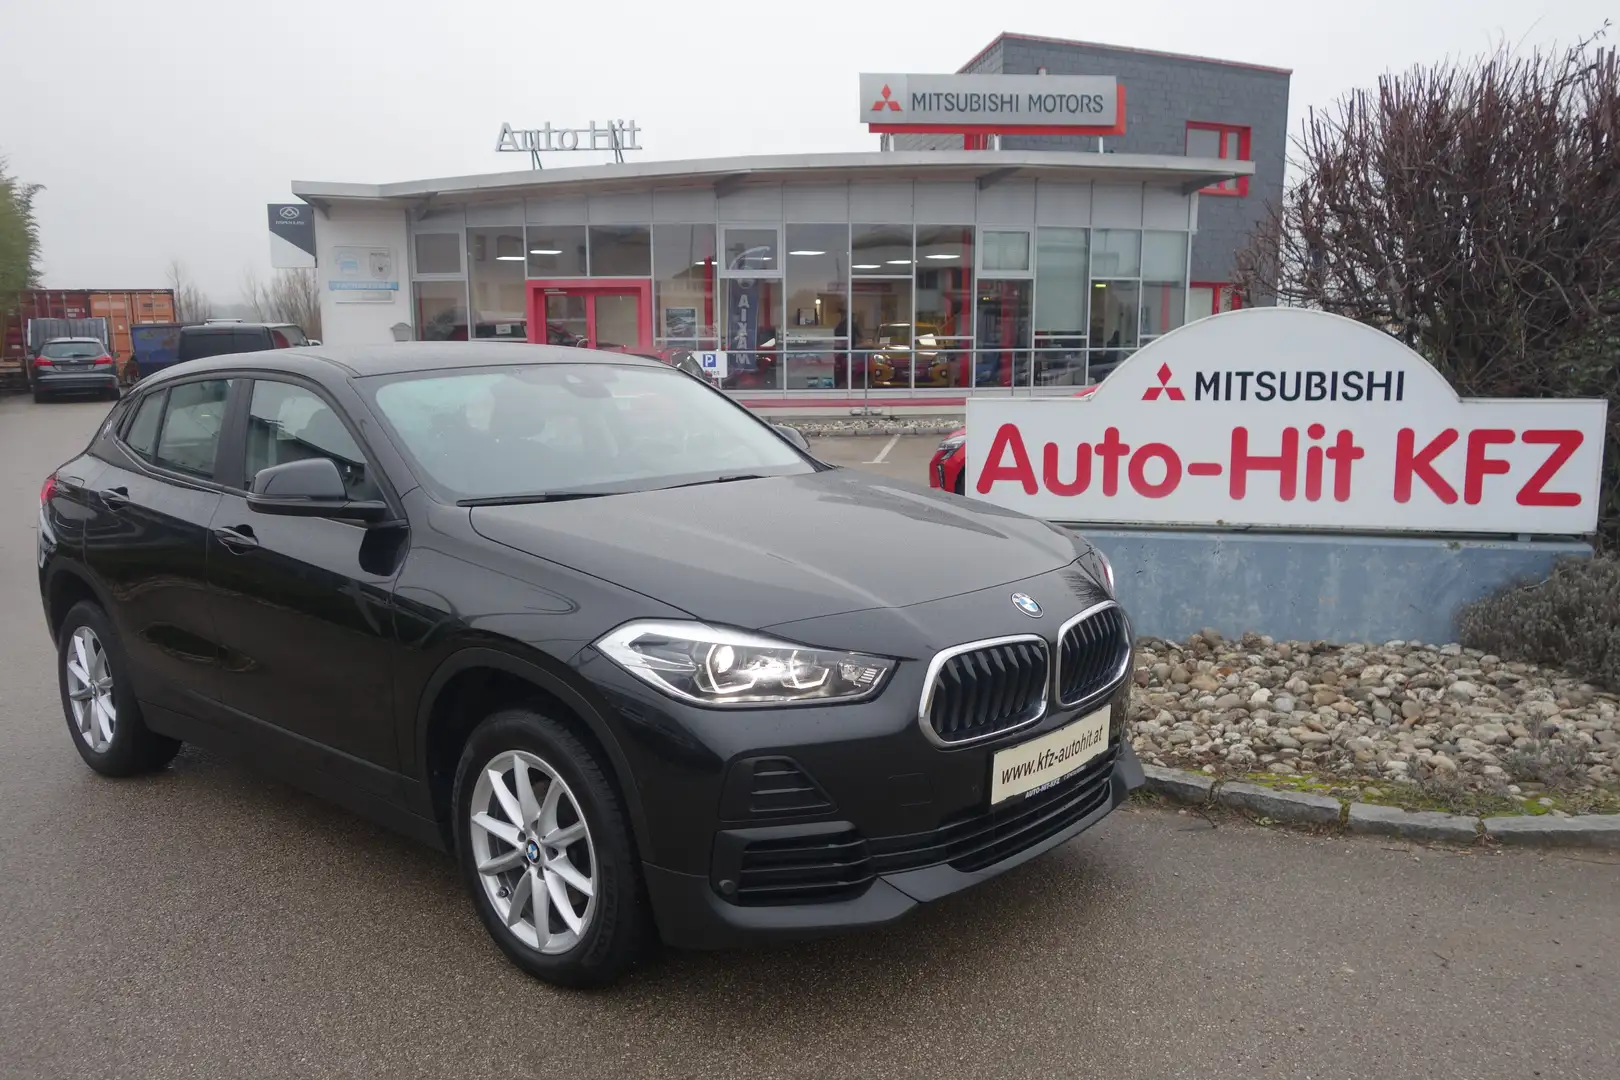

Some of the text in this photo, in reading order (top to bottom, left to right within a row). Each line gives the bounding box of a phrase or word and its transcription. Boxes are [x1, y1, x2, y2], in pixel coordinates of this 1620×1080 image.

[911, 92, 1104, 115] MITSUBISHI MOTORS
[495, 119, 643, 152] Auto Hit
[705, 354, 714, 367] P
[1194, 370, 1405, 402] MITSUBISHI
[976, 423, 1585, 507] Auto-Hit KFZ
[1001, 724, 1104, 785] www.kfz-autohit.at
